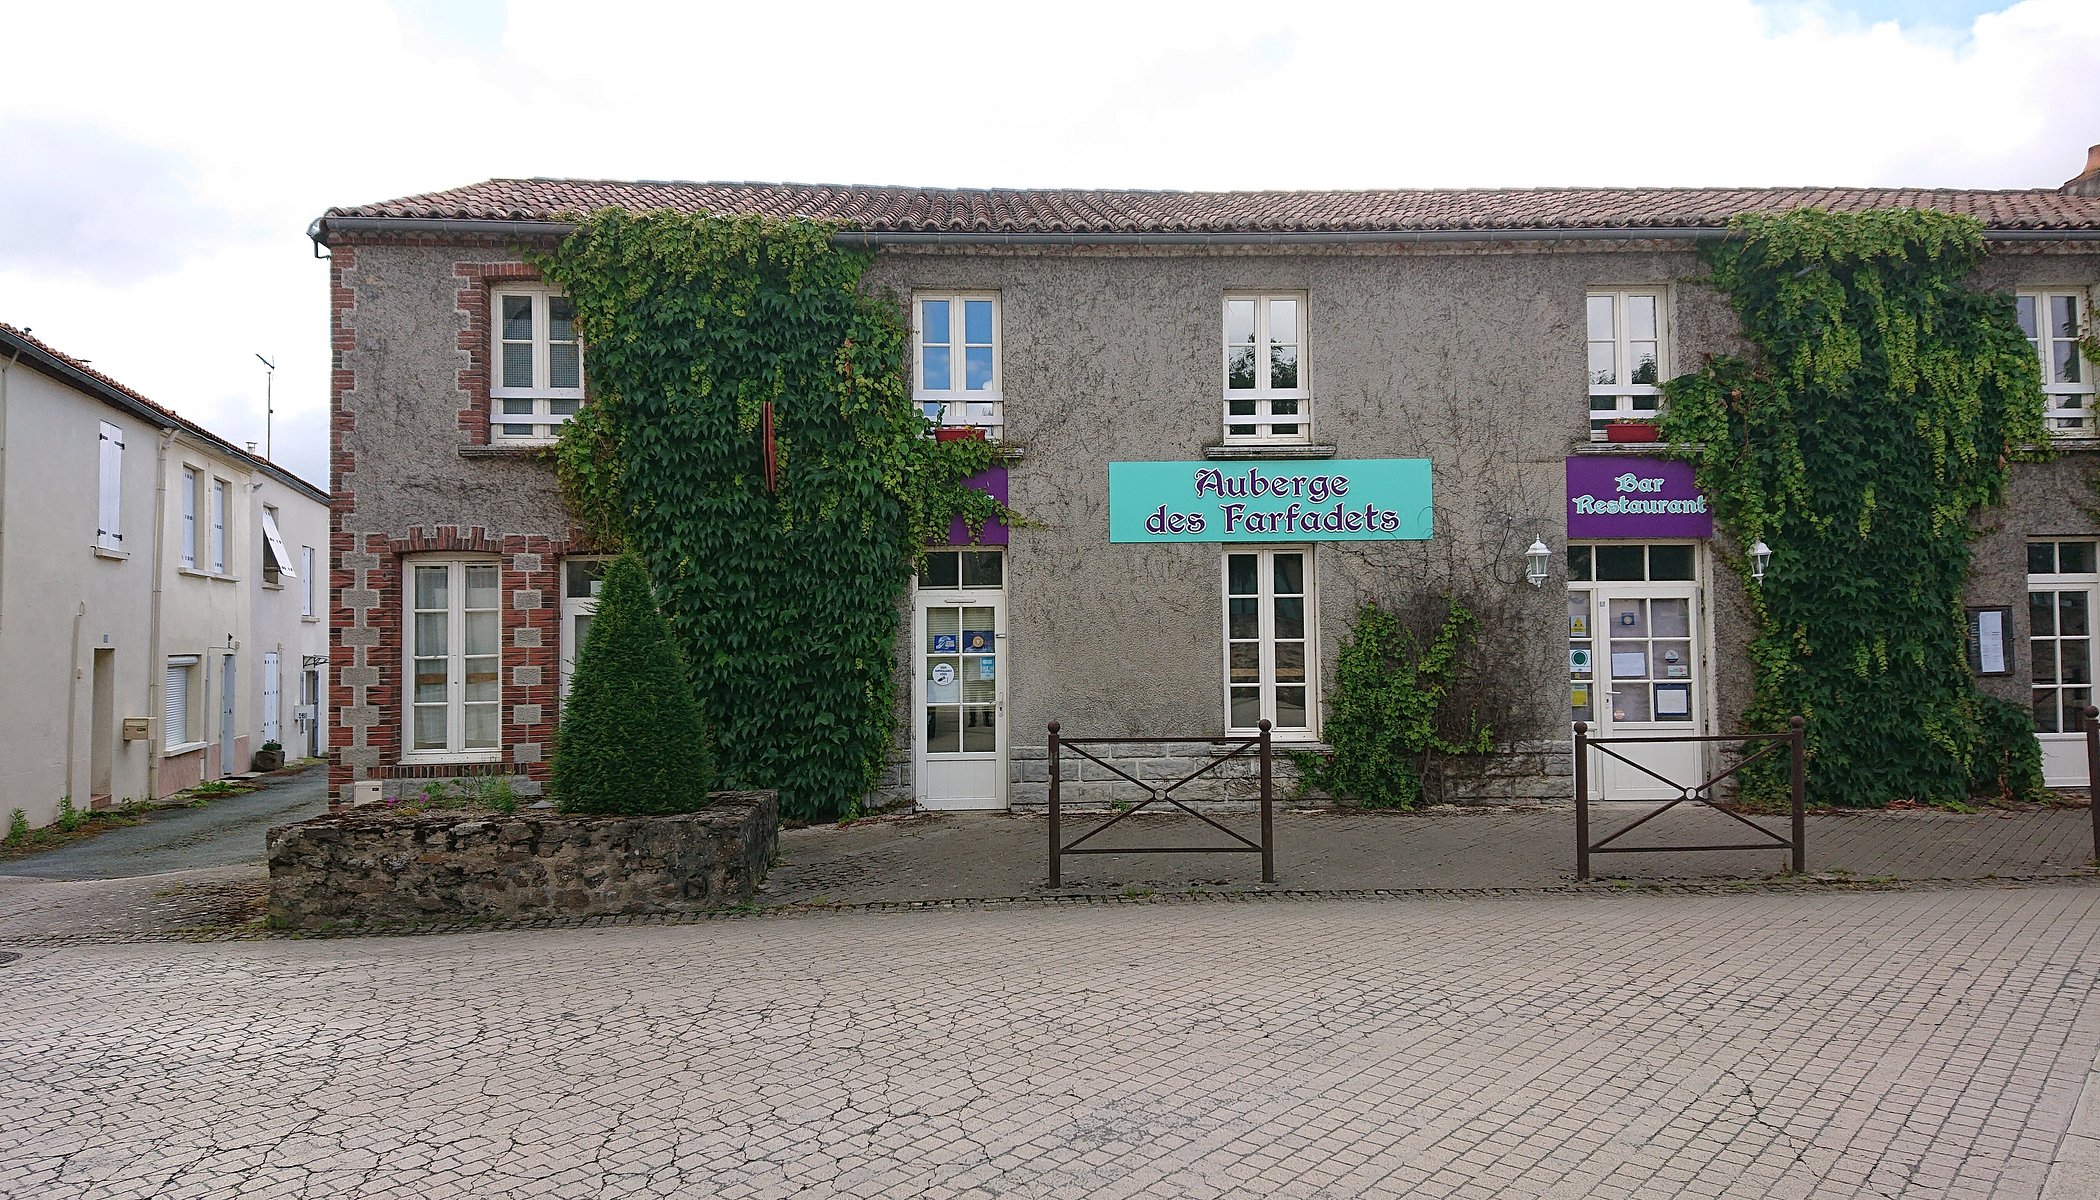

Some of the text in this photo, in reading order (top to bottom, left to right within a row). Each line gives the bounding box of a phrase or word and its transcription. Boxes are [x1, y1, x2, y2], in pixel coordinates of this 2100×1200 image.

[1195, 467, 1350, 503] Auberge
[1615, 473, 1665, 493] Bar
[1572, 494, 1708, 514] Restaurant
[1145, 502, 1401, 534] des Farfadets
